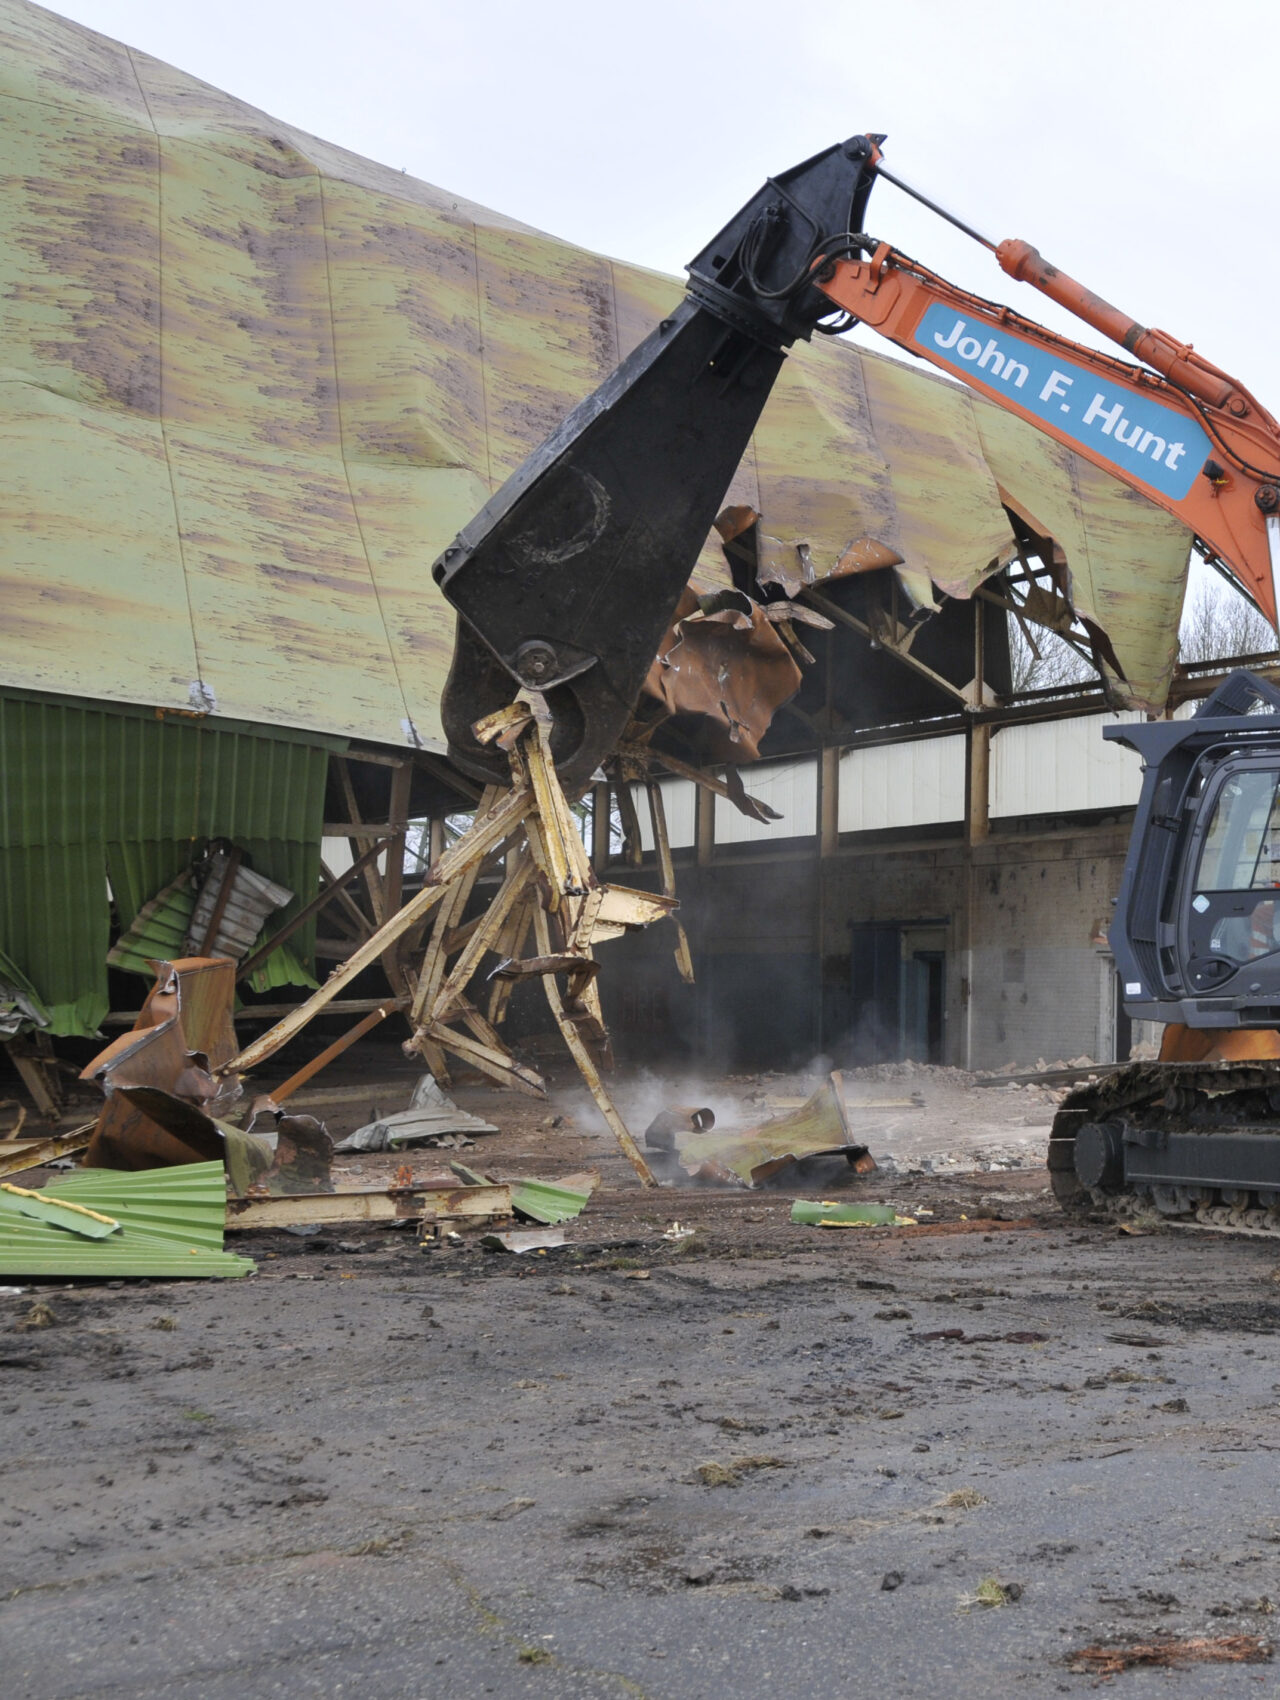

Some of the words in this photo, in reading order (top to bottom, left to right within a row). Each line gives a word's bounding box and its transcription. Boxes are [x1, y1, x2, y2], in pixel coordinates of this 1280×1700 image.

[933, 320, 1030, 388] John
[1038, 369, 1074, 414] F.
[1081, 393, 1187, 471] Hunt
